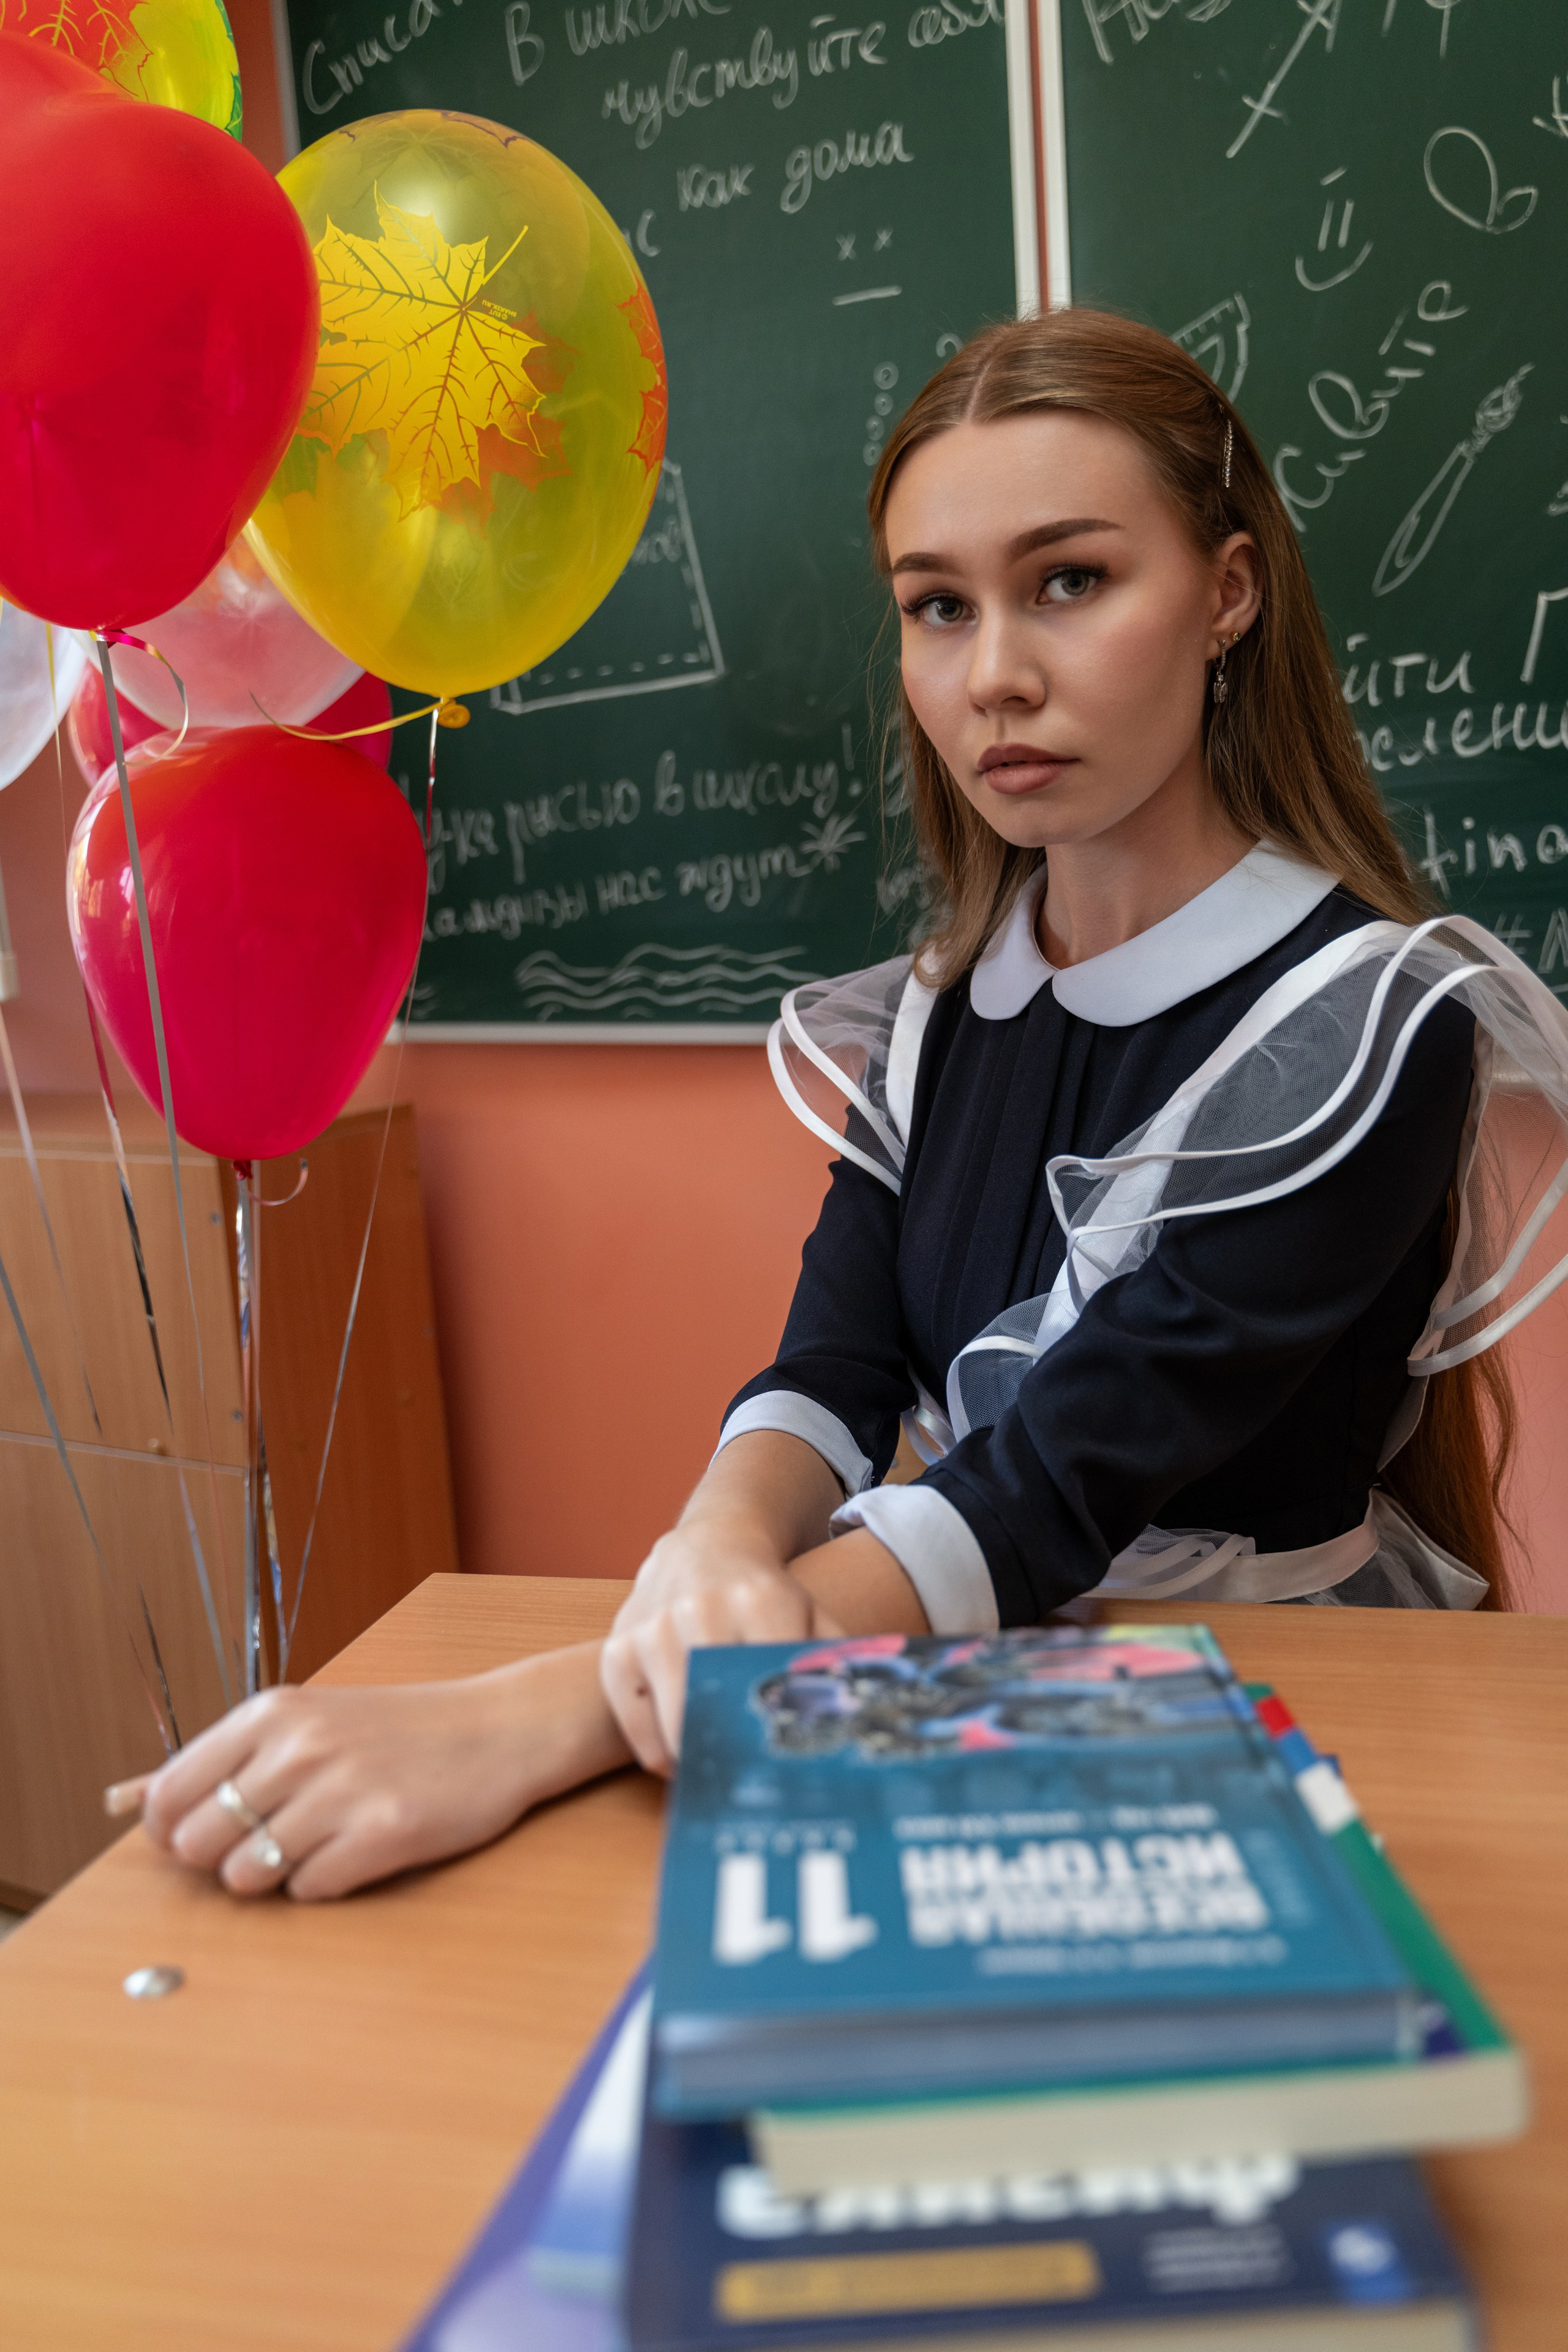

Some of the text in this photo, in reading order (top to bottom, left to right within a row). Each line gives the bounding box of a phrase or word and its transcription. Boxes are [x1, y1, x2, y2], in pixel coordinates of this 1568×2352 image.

[676, 121, 915, 214] как дома
[1341, 632, 1475, 707] йти
[594, 864, 668, 915] нас
[712, 1850, 878, 1967] 11
